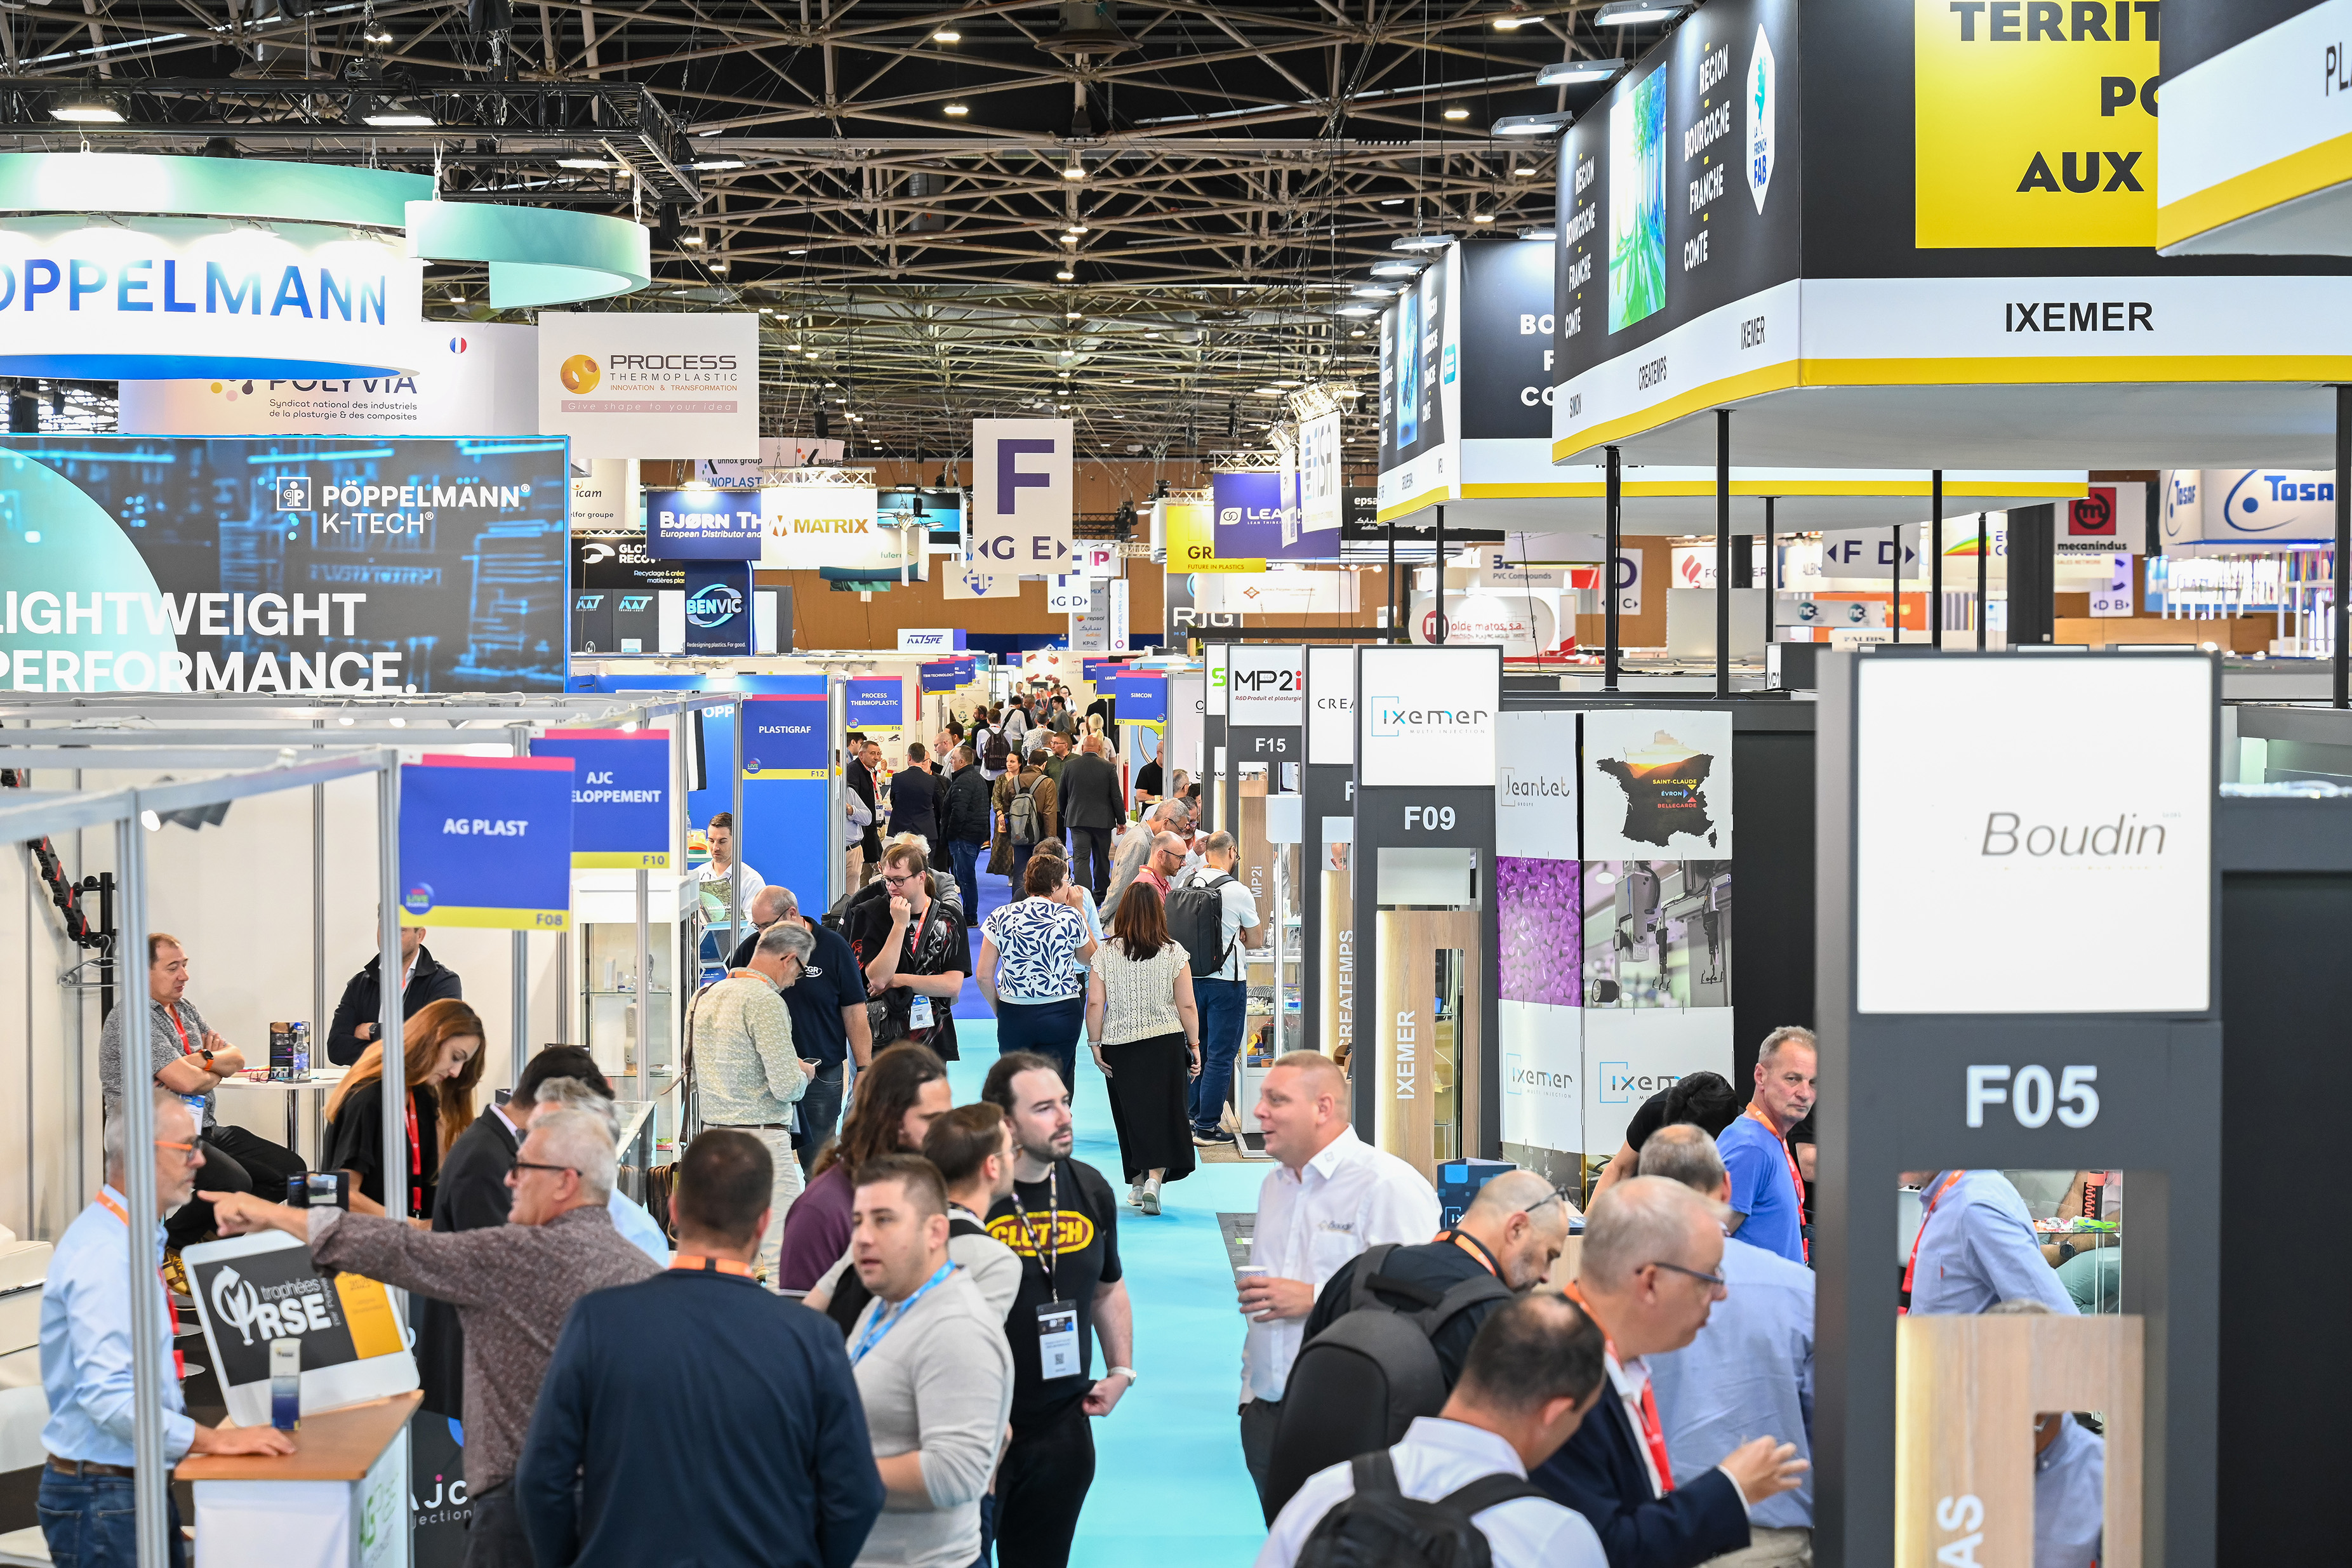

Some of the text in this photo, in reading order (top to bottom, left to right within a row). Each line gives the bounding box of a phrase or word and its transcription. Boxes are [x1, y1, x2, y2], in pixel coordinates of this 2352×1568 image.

[1950, 0, 2160, 42] TERRIT
[1699, 44, 1729, 96] REGION
[2325, 41, 2352, 97] PL
[1684, 100, 1731, 163] BOURGOGNE
[1754, 136, 1767, 157] FRENCH
[1576, 156, 1595, 196] REGION
[1754, 154, 1767, 189] FAB
[2016, 151, 2144, 194] AUX
[1689, 163, 1724, 215] FRANCHE
[1566, 201, 1596, 248] BOURGOGNE
[1684, 229, 1709, 273] COMTE
[1569, 253, 1591, 293] FRANCHE
[1565, 306, 1581, 340] COMTE
[2005, 302, 2155, 333] IXEMER
[1741, 315, 1765, 351] IXEMER
[610, 354, 738, 370] PROCESS
[1638, 355, 1667, 392] CREATEMPS
[610, 373, 738, 381] THERMOPLASTIC
[270, 399, 310, 409] Syndicat
[371, 402, 418, 410] industriels
[293, 410, 337, 420] plasturgie
[367, 413, 418, 421] composites
[568, 402, 732, 412] Give shape to your idea
[1569, 392, 1583, 420] SIMON
[702, 477, 763, 488] ANOPLAST
[997, 438, 1055, 515] F
[576, 488, 602, 498] icam
[660, 511, 730, 529] BJØRN
[794, 518, 869, 534] MATRIX
[660, 529, 762, 539] European Distributor and
[991, 535, 1051, 561] G E
[1844, 540, 1863, 564] F
[0, 590, 366, 636] IGHTWEIGHT
[686, 599, 743, 615] BENVIC
[1056, 596, 1082, 606] G D
[1622, 598, 1633, 609] C
[2099, 600, 2124, 611] D B
[0, 649, 418, 693] ERFORMANCE.
[1234, 670, 1302, 691] MP2i
[758, 725, 812, 734] PLASTIGRAF
[1383, 710, 1488, 725] ixemer
[1255, 738, 1287, 753] F15
[587, 771, 614, 785] AJC
[442, 818, 529, 837] AG PLAST
[1404, 806, 1456, 831] F09
[1981, 811, 2167, 858] Boudin
[642, 855, 665, 866] F10
[1251, 865, 1263, 898] MP2i
[536, 913, 562, 927] F08
[1397, 1009, 1416, 1100] IXEMER
[1512, 1066, 1572, 1089] ixemer
[1965, 1063, 2101, 1129] F05
[260, 1276, 322, 1301] trophées
[256, 1292, 333, 1341] RSE
